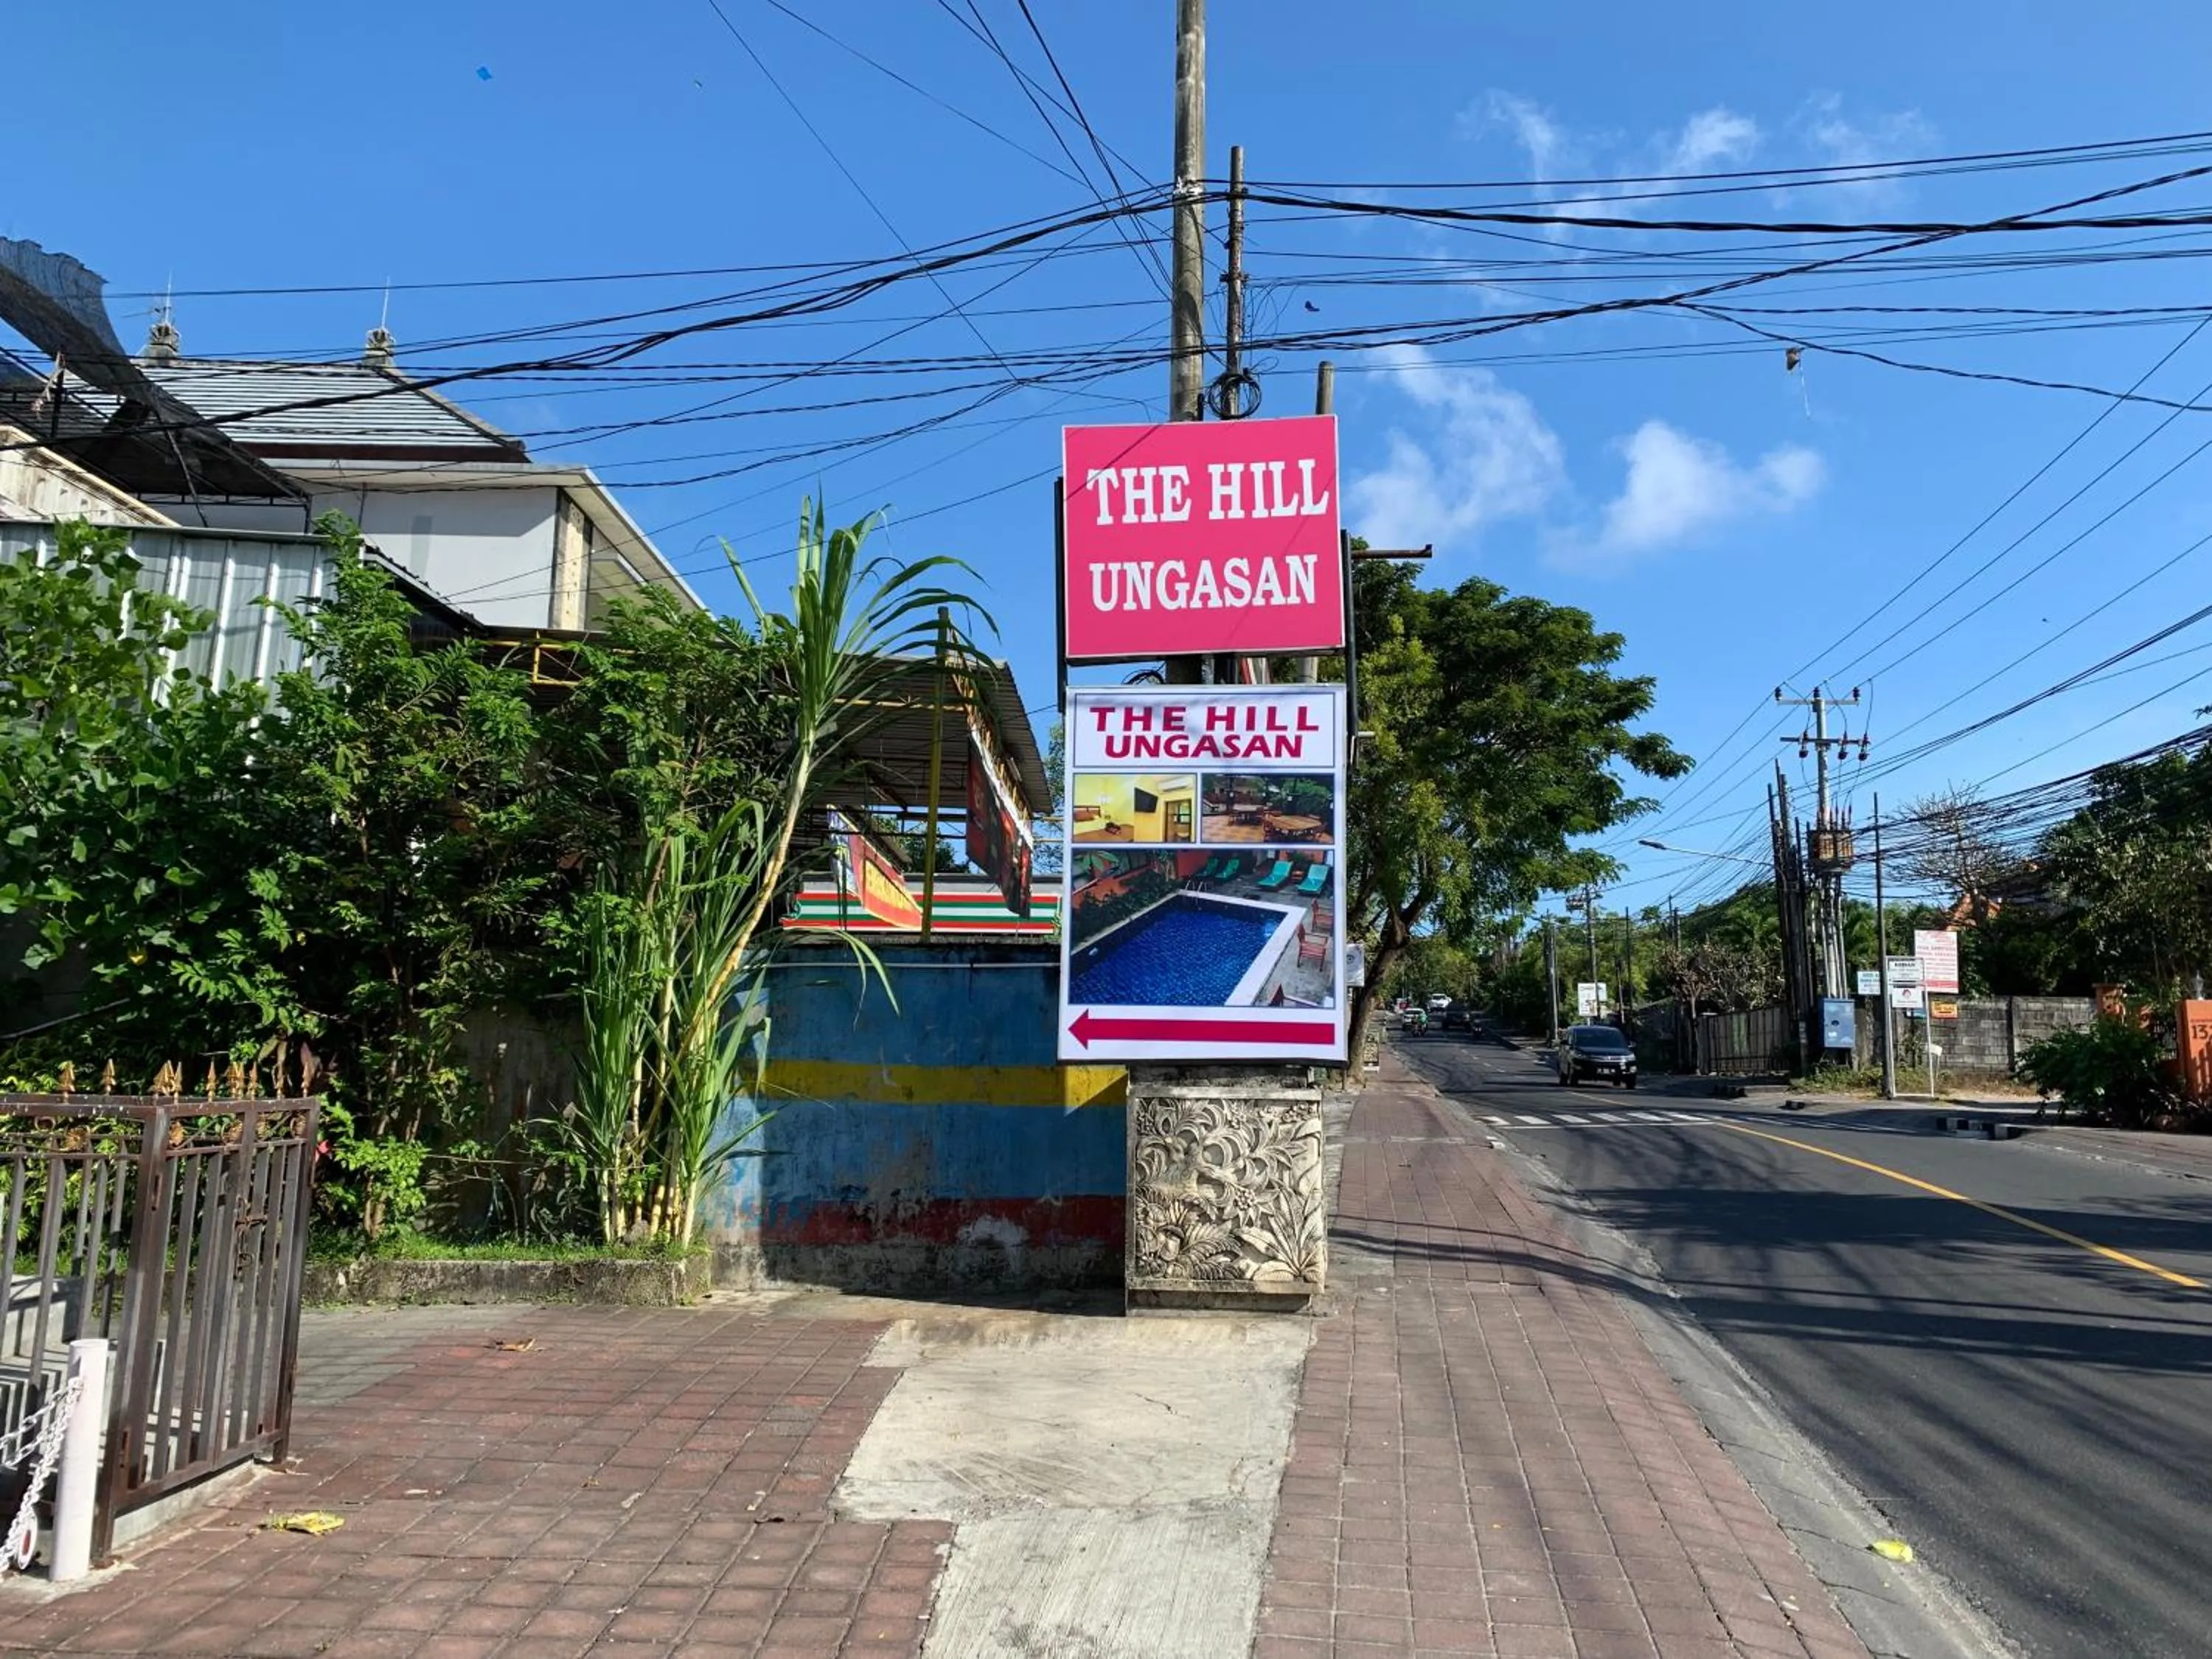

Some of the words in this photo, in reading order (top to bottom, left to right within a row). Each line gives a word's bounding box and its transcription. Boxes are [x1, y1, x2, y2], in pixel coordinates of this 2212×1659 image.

[1086, 465, 1191, 526] THE
[1207, 459, 1329, 520] HILL
[1089, 554, 1318, 612] UNGASAN
[1090, 707, 1188, 732] THE
[1207, 706, 1320, 731] HILL
[1105, 734, 1303, 759] UNGASAN
[2192, 1024, 2212, 1039] 13
